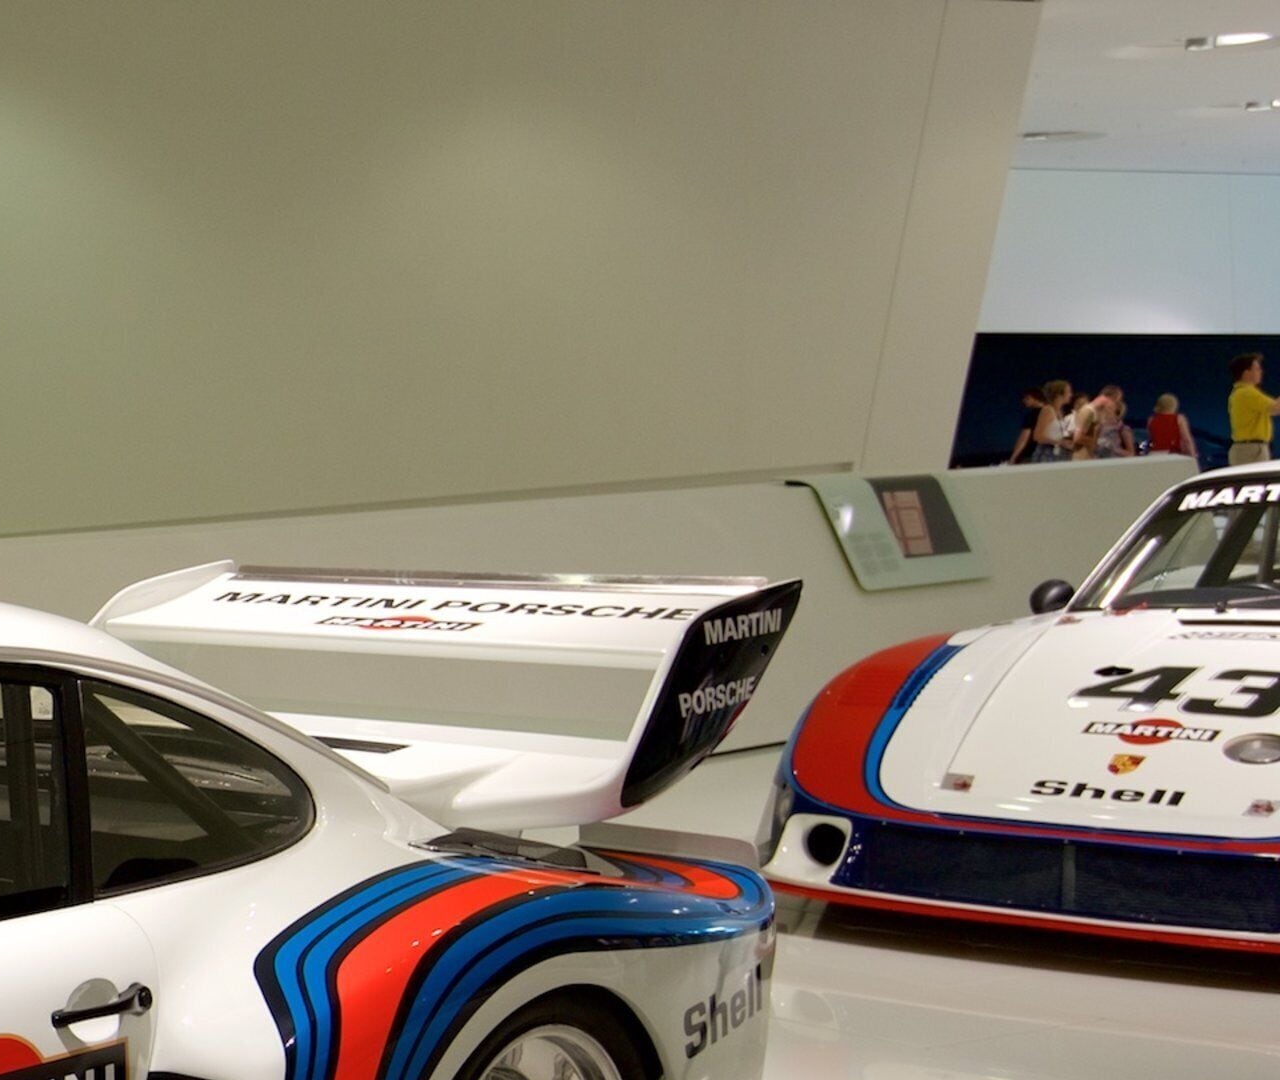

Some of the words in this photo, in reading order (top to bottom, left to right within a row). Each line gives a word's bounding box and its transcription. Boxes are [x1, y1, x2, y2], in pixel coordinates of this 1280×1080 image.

[215, 592, 425, 612] MARTINI
[433, 600, 704, 622] PORSCHE
[340, 616, 465, 632] MARTINI
[704, 608, 782, 645] MARTINI
[678, 677, 757, 719] PORSCHE
[1089, 723, 1215, 742] MARTINI
[1030, 780, 1186, 807] Shell
[683, 963, 763, 1059] Shell
